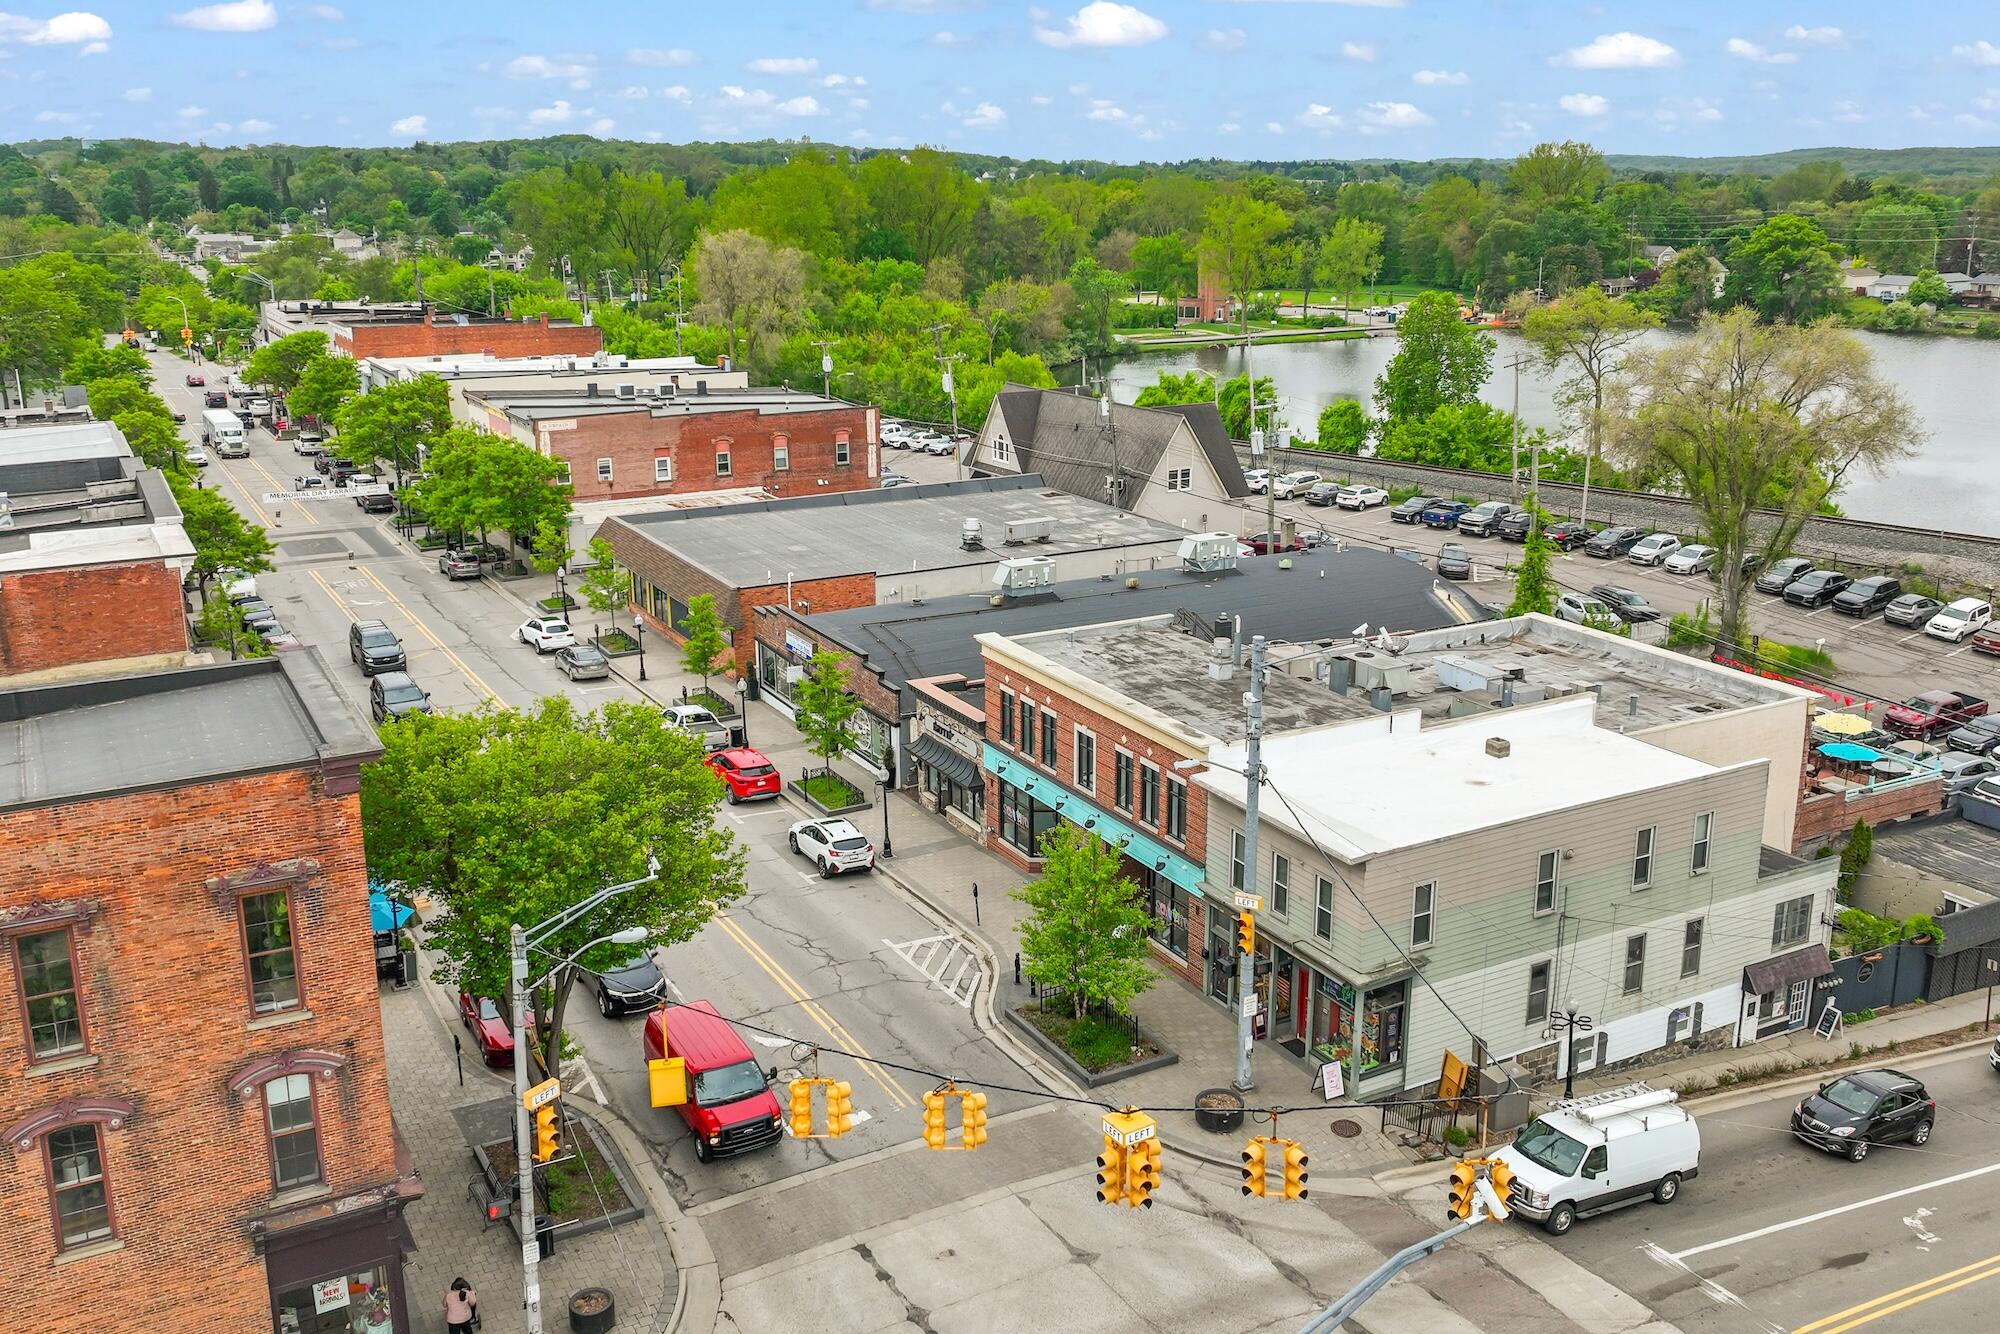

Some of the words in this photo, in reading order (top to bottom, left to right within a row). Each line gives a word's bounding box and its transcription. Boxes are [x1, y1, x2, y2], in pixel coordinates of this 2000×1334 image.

[269, 490, 310, 499] MEMORIAL
[329, 487, 358, 495] PARADE
[1237, 898, 1255, 907] LEFT
[535, 1087, 556, 1104] LEFT
[1104, 1122, 1120, 1140] LEFT
[1129, 1127, 1150, 1143] LEFT
[323, 1287, 340, 1298] NEW
